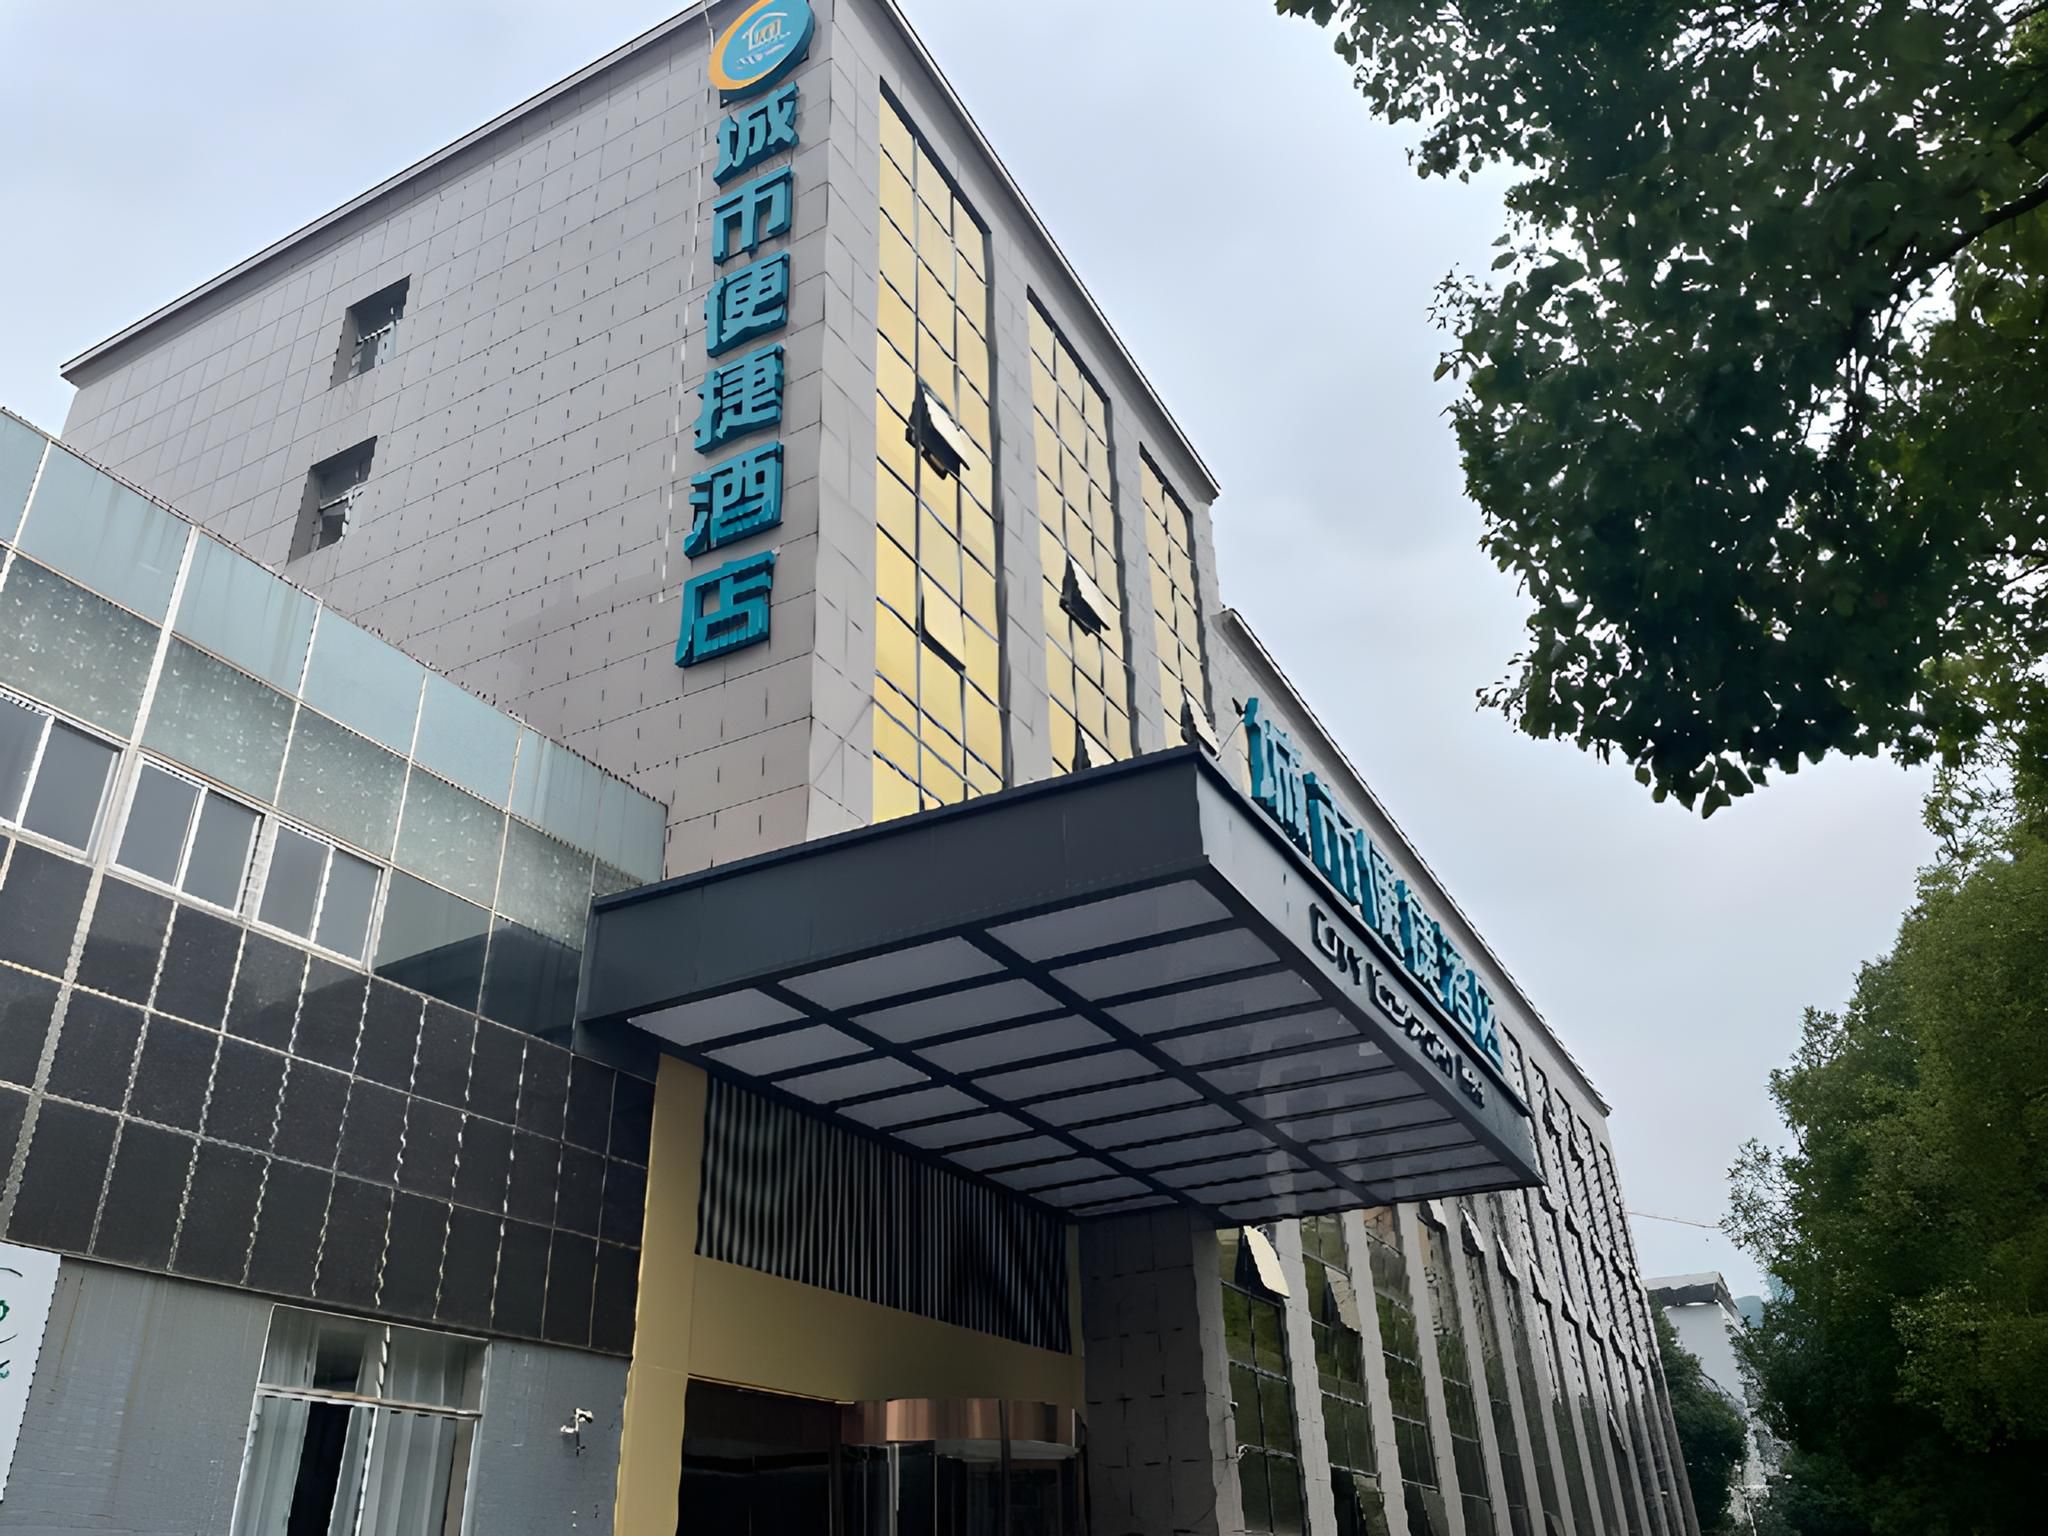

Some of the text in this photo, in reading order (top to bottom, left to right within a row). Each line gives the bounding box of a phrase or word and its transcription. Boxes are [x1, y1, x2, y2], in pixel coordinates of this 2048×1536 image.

[675, 81, 799, 667] 城市便捷酒店
